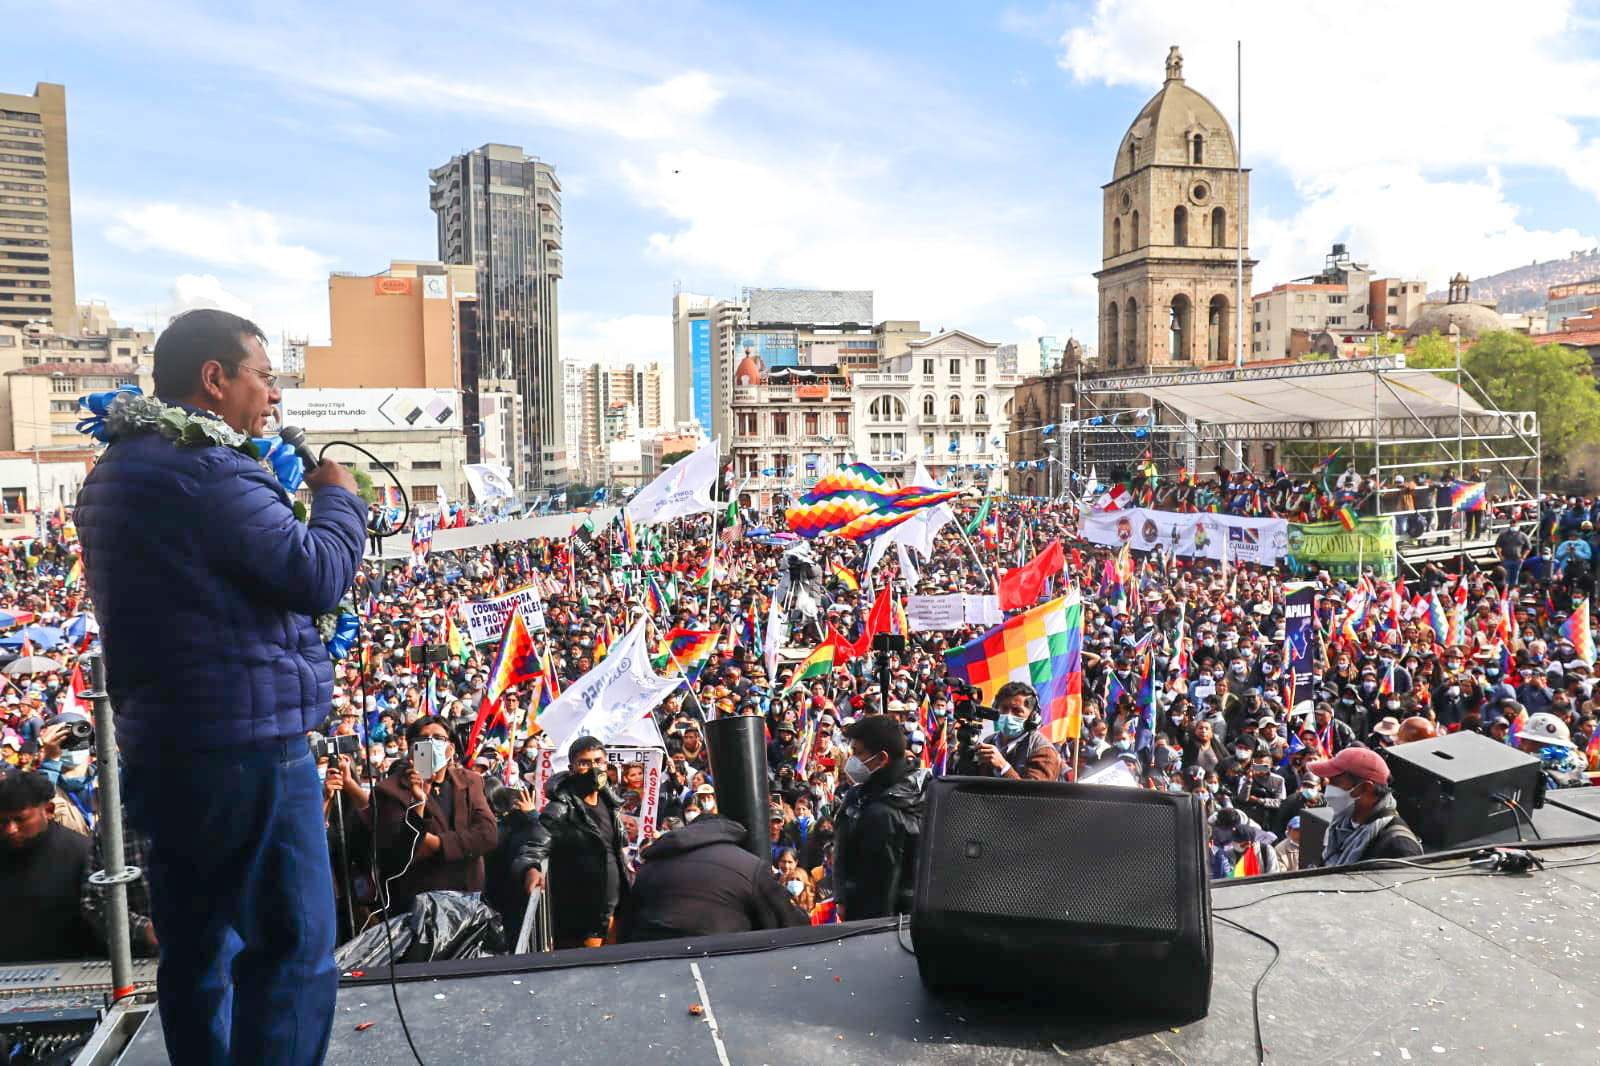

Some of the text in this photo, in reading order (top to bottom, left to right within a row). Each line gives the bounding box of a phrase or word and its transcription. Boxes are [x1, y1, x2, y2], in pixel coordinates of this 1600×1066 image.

[287, 409, 327, 417] Despliega
[471, 616, 481, 628] DE
[635, 751, 650, 763] DE
